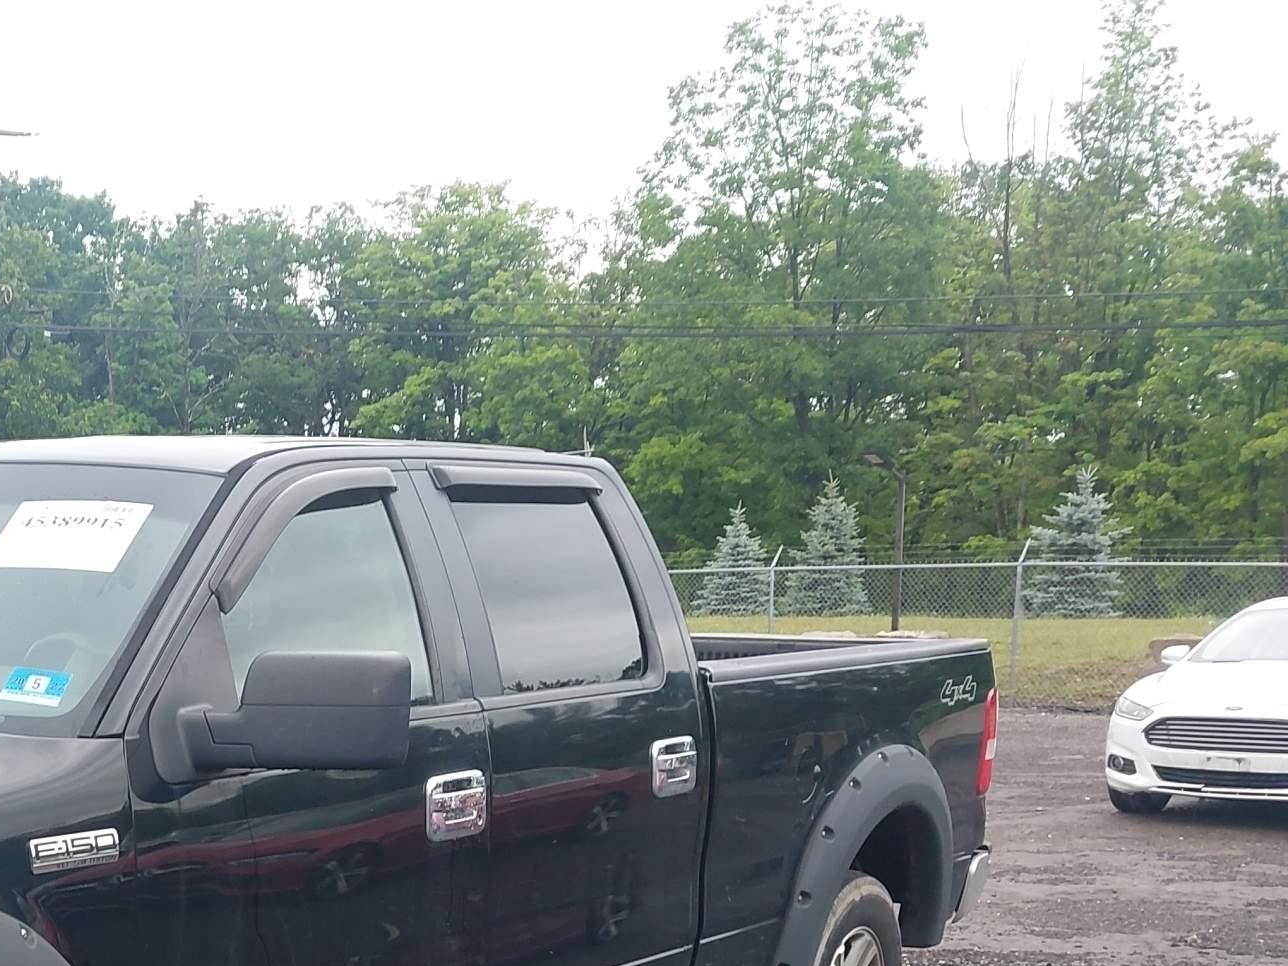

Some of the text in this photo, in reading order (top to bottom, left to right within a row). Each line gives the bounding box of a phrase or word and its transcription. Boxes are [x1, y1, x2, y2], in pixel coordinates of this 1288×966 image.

[31, 678, 41, 689] 5
[940, 675, 977, 706] 4x4
[33, 833, 117, 861] F-150
